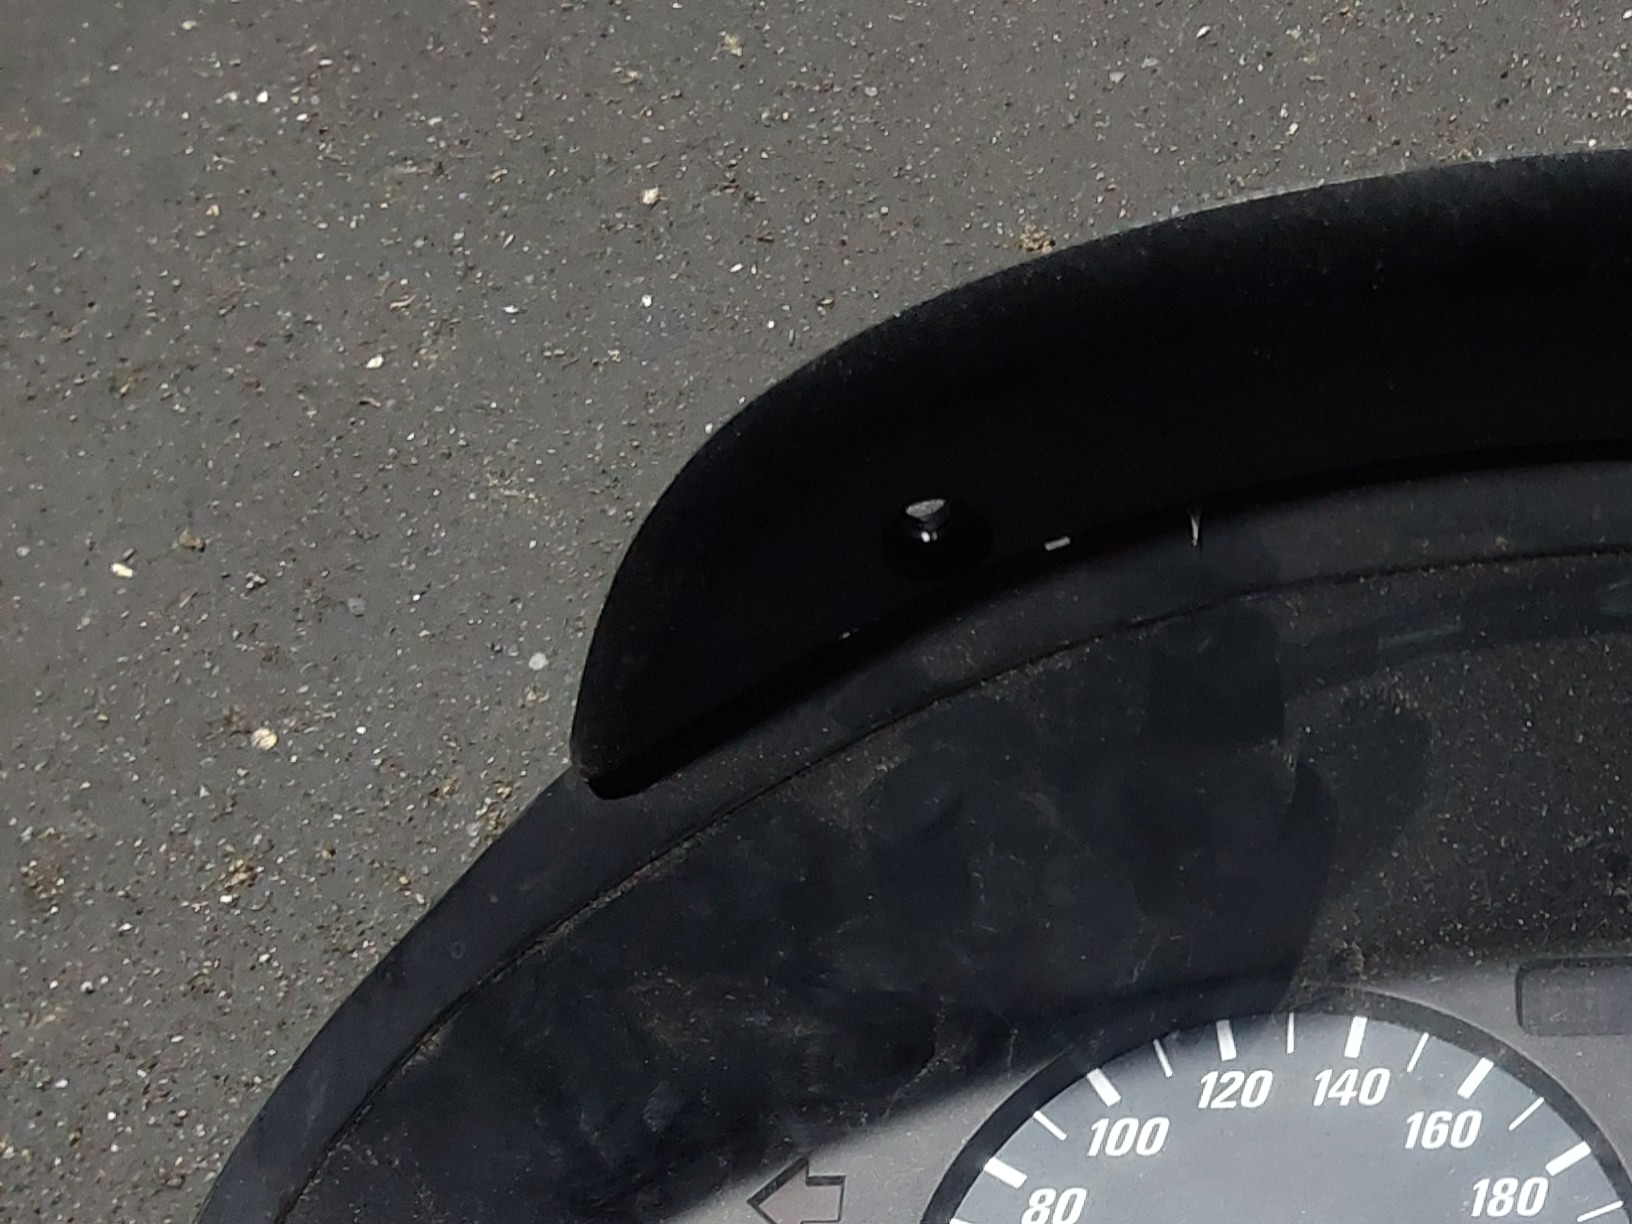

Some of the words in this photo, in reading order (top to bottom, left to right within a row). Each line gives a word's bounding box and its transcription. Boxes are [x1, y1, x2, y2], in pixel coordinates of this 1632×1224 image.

[1198, 1070, 1273, 1109] 120
[1313, 1068, 1390, 1107] 140
[1087, 1117, 1169, 1157] 100
[1404, 1110, 1482, 1150] 160
[1470, 1177, 1549, 1217] 180
